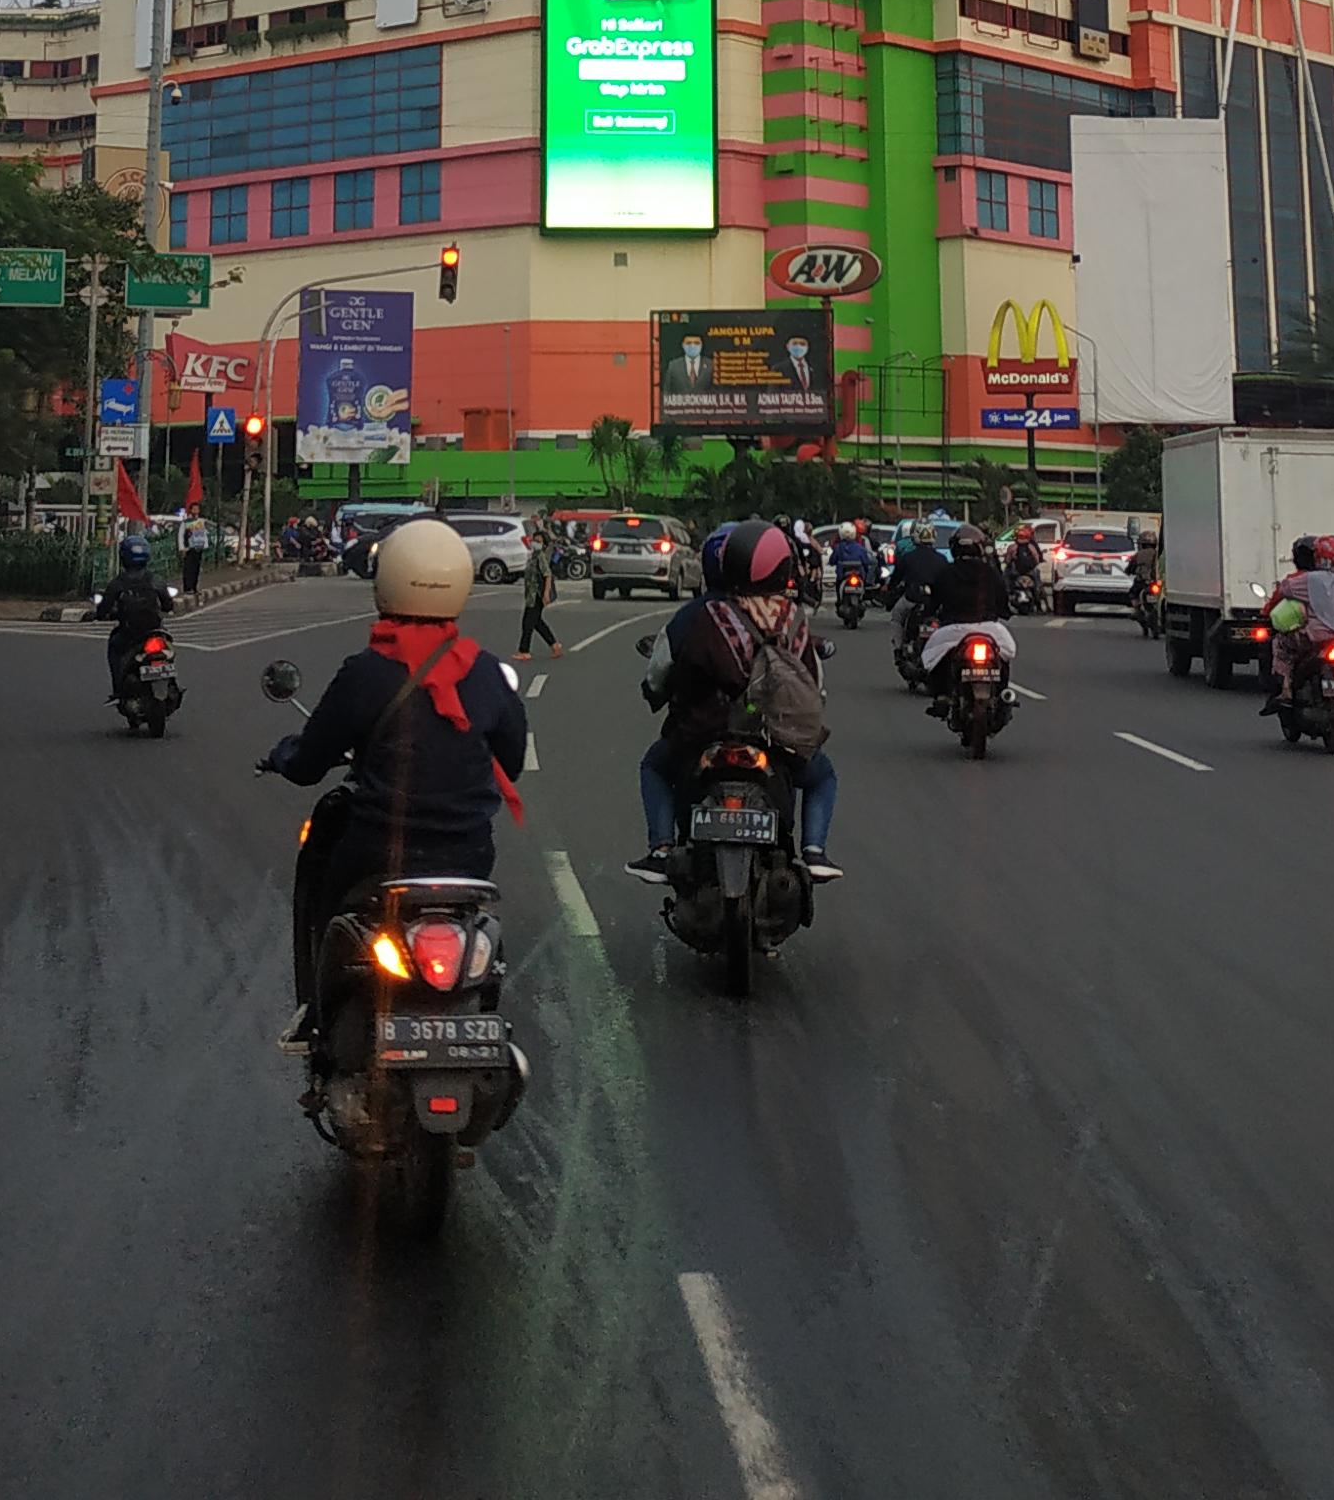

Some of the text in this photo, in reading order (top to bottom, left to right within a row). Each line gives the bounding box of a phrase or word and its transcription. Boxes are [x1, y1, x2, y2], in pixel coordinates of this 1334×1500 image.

[566, 36, 694, 61] GrabExpress
[9, 267, 58, 281] MELAYU
[329, 307, 384, 319] GENTLE
[342, 320, 373, 330] GEN
[707, 327, 775, 336] JANGAN LUPA
[182, 352, 249, 381] KFC
[987, 373, 1069, 384] McDonald's
[1024, 409, 1053, 427] 24
[385, 1021, 396, 1040] B
